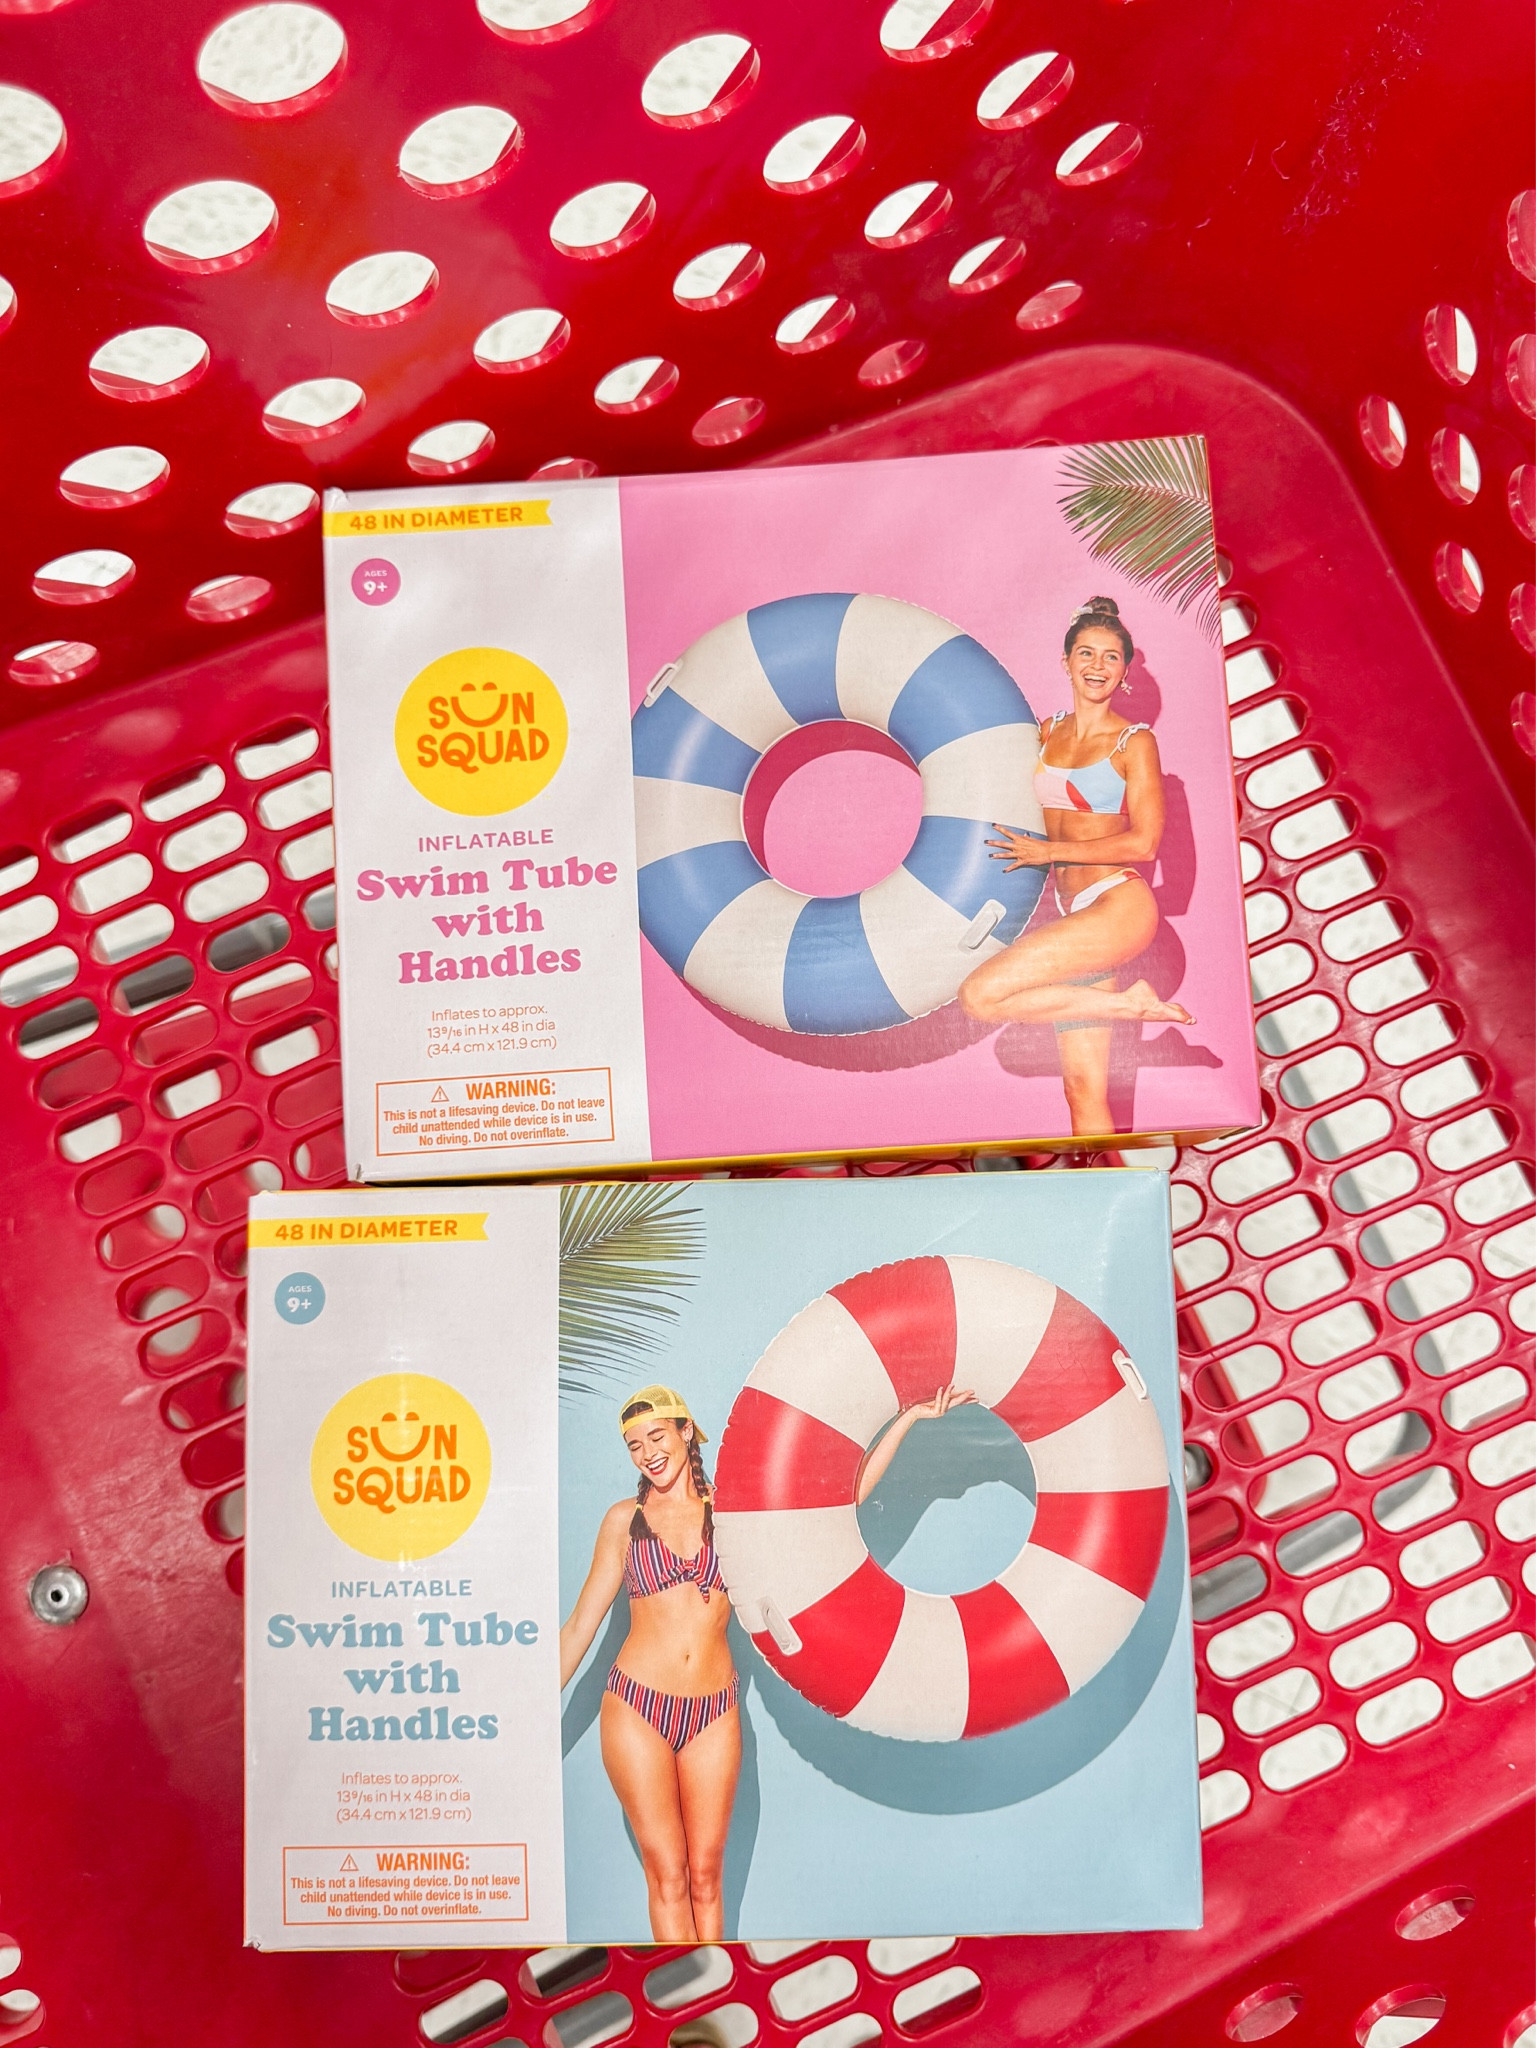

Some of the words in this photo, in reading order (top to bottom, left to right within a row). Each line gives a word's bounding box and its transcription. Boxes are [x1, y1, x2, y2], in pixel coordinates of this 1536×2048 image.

[350, 515, 377, 531] 48
[384, 513, 405, 529] IN
[412, 506, 523, 528] DIAMETER
[363, 581, 388, 596] 9+
[429, 691, 535, 730] SUN
[417, 729, 549, 774] SQUAD
[418, 829, 554, 852] INFLATABLE
[357, 866, 490, 901] Swim
[503, 856, 618, 891] Tube
[432, 902, 544, 938] with
[398, 944, 581, 984] Handles
[431, 1009, 480, 1021] Inflates
[483, 1008, 496, 1018] to
[499, 1005, 548, 1019] approx.
[464, 1024, 476, 1036] in
[479, 1023, 489, 1035] H
[491, 1025, 499, 1034] x
[501, 1021, 519, 1033] 48
[521, 1020, 533, 1032] in
[536, 1019, 556, 1031] dia
[427, 1042, 460, 1058] (34.4
[463, 1042, 484, 1053] cm
[487, 1042, 495, 1051] x
[497, 1037, 528, 1051] 121.9
[530, 1036, 557, 1050] cm)
[465, 1078, 556, 1100] WARNING:
[383, 1110, 405, 1121] This
[408, 1109, 417, 1119] is
[420, 1107, 437, 1119] not
[439, 1108, 446, 1118] a
[449, 1104, 499, 1116] lifesaving
[502, 1102, 539, 1113] device.
[541, 1100, 555, 1111] Do
[558, 1099, 575, 1110] not
[577, 1098, 605, 1108] leave
[392, 1122, 418, 1134] child
[421, 1118, 480, 1132] unattended
[483, 1117, 511, 1128] while
[514, 1114, 548, 1127] device
[550, 1113, 560, 1124] is
[563, 1112, 572, 1123] in
[575, 1112, 597, 1122] use.
[419, 1135, 433, 1146] No
[436, 1133, 472, 1146] diving.
[474, 1132, 487, 1143] Do
[490, 1130, 508, 1141] not
[510, 1127, 569, 1140] overinflate.
[275, 1224, 304, 1241] 48
[311, 1223, 333, 1239] IN
[340, 1220, 458, 1239] DIAMETER
[288, 1285, 312, 1293] AGES
[287, 1297, 311, 1313] 9+
[347, 1424, 457, 1462] SUN
[333, 1465, 471, 1514] SQUAD
[331, 1579, 473, 1598] INFLATABLE
[267, 1613, 404, 1649] Swim
[417, 1611, 539, 1647] Tube
[343, 1660, 461, 1695] with
[308, 1706, 499, 1741] Handles
[341, 1771, 392, 1785] Inflates
[394, 1773, 409, 1785] to
[411, 1773, 463, 1786] approx.
[375, 1789, 387, 1802] in
[390, 1790, 401, 1802] H
[404, 1792, 412, 1801] x
[414, 1789, 432, 1801] 48
[435, 1789, 447, 1801] in
[450, 1789, 471, 1801] dia
[336, 1808, 371, 1824] (34.4
[374, 1810, 396, 1820] cm
[399, 1811, 407, 1820] x
[409, 1807, 441, 1820] 121.9
[444, 1807, 472, 1822] cm)
[376, 1852, 470, 1871] WARNING:
[290, 1877, 313, 1888] This
[316, 1877, 325, 1888] is
[328, 1877, 346, 1888] not
[349, 1879, 355, 1888] a
[358, 1876, 410, 1889] lifesaving
[413, 1875, 452, 1887] device.
[454, 1875, 469, 1886] Do
[471, 1874, 489, 1886] not
[492, 1874, 520, 1886] leave
[300, 1891, 327, 1903] child
[330, 1890, 391, 1902] unattended
[393, 1890, 422, 1902] while
[425, 1889, 461, 1901] device
[463, 1888, 473, 1900] is
[476, 1888, 486, 1900] in
[489, 1890, 512, 1900] use.
[327, 1905, 342, 1917] No
[344, 1904, 381, 1919] diving.
[383, 1904, 398, 1916] Do
[401, 1904, 418, 1916] not
[421, 1903, 482, 1915] overinflate.
